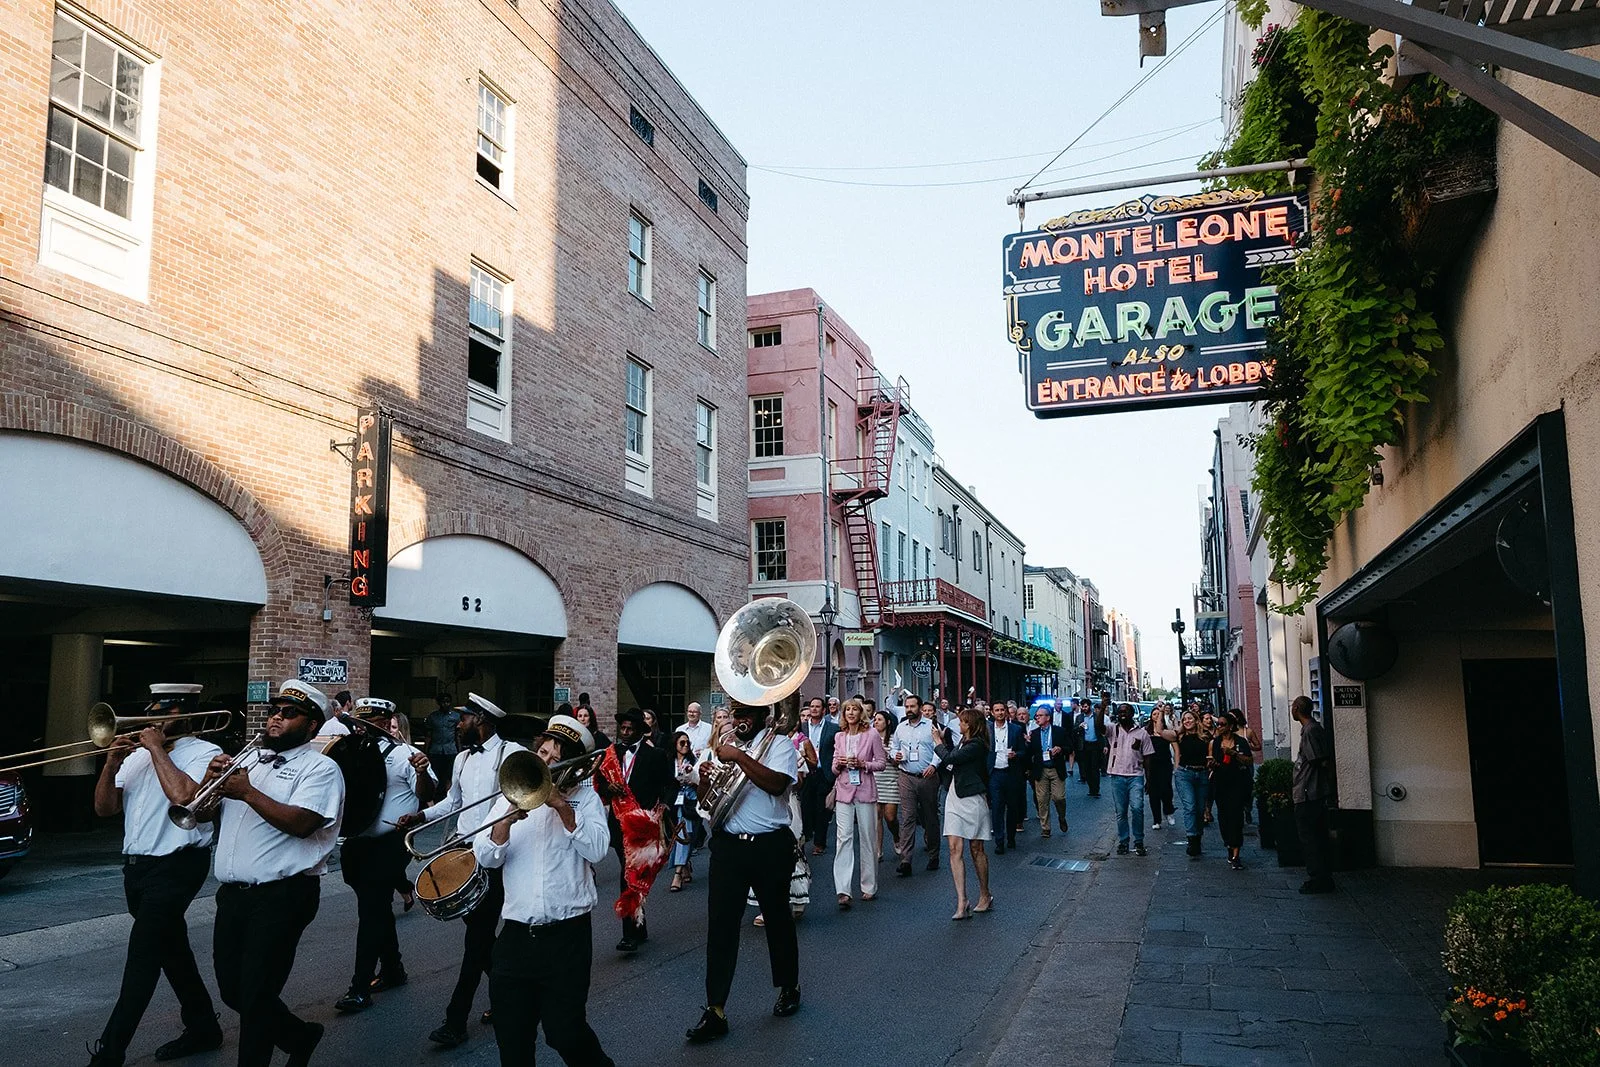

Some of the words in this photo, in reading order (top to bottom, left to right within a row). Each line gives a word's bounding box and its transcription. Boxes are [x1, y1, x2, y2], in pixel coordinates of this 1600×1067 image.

[1020, 206, 1288, 269] MONTELEONE
[1084, 254, 1219, 295] HOTEL
[1034, 285, 1280, 352] GARAGE
[1121, 343, 1186, 367] ALSO
[1036, 370, 1167, 404] ENTRANCE
[1169, 366, 1193, 391] to
[351, 414, 376, 597] PARKING
[312, 666, 326, 676] ONE
[327, 666, 343, 676] WAY
